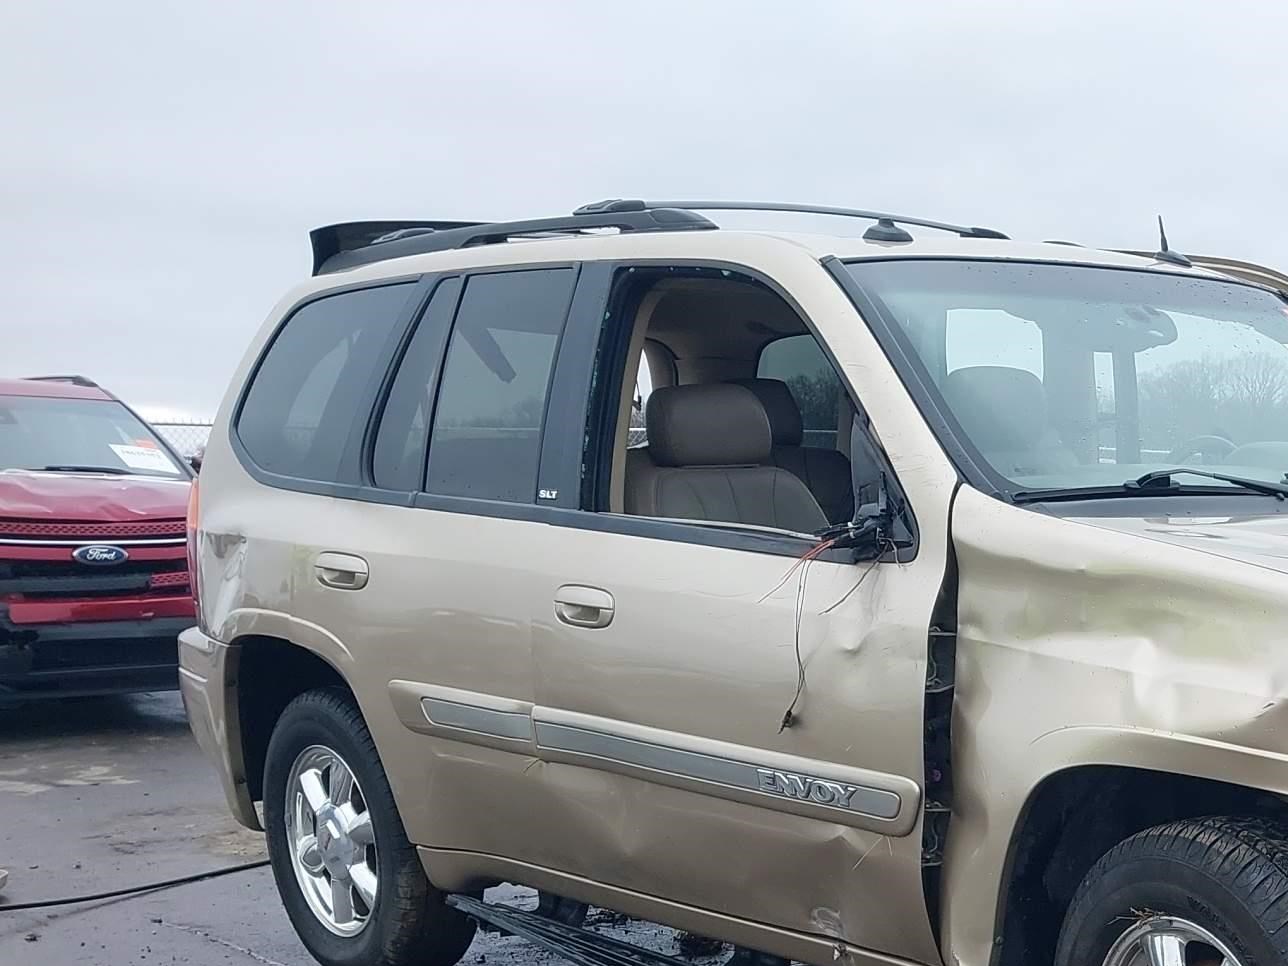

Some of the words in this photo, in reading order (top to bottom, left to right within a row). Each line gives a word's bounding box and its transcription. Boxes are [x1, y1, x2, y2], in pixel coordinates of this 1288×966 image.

[538, 489, 558, 499] SLT
[86, 547, 117, 561] Ford
[756, 768, 857, 808] ENVOY
